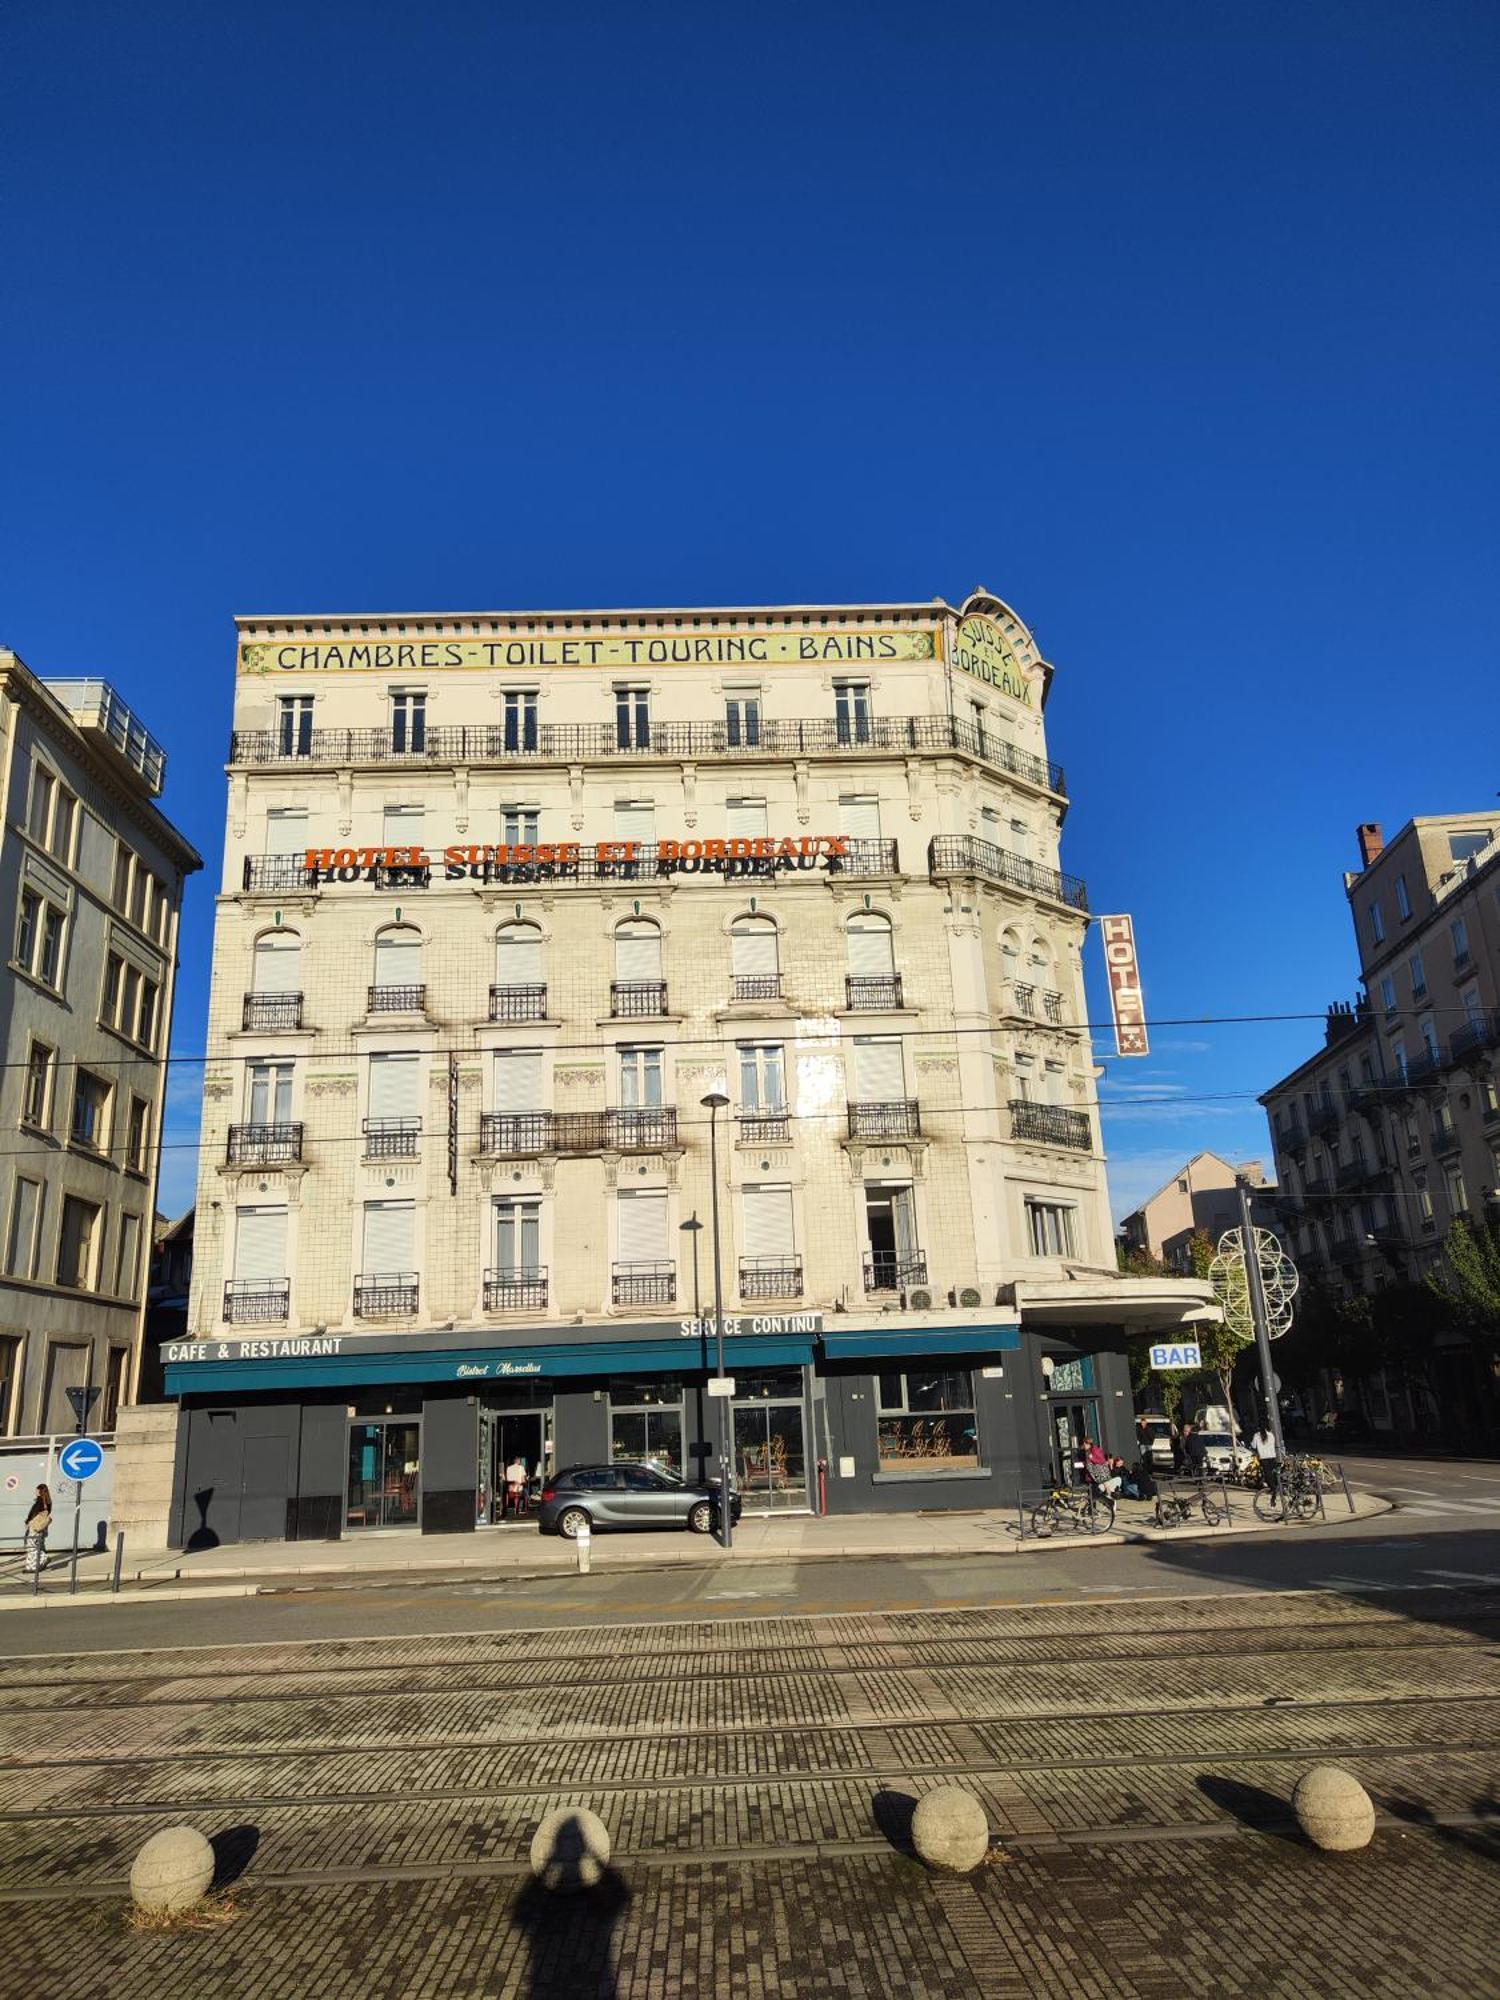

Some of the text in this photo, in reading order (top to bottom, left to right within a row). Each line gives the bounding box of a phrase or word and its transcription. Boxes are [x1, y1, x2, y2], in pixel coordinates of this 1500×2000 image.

[800, 635, 897, 660] BAINS
[962, 620, 1012, 667] SUISSE
[304, 836, 850, 869] HOTEL SUISSE ET BORDEAUX
[1104, 918, 1141, 1034] HOTEL
[680, 1315, 816, 1336] SERVCE CONTINU
[168, 1338, 342, 1361] CAFE & RESTAURANT
[1153, 1347, 1199, 1365] BAR
